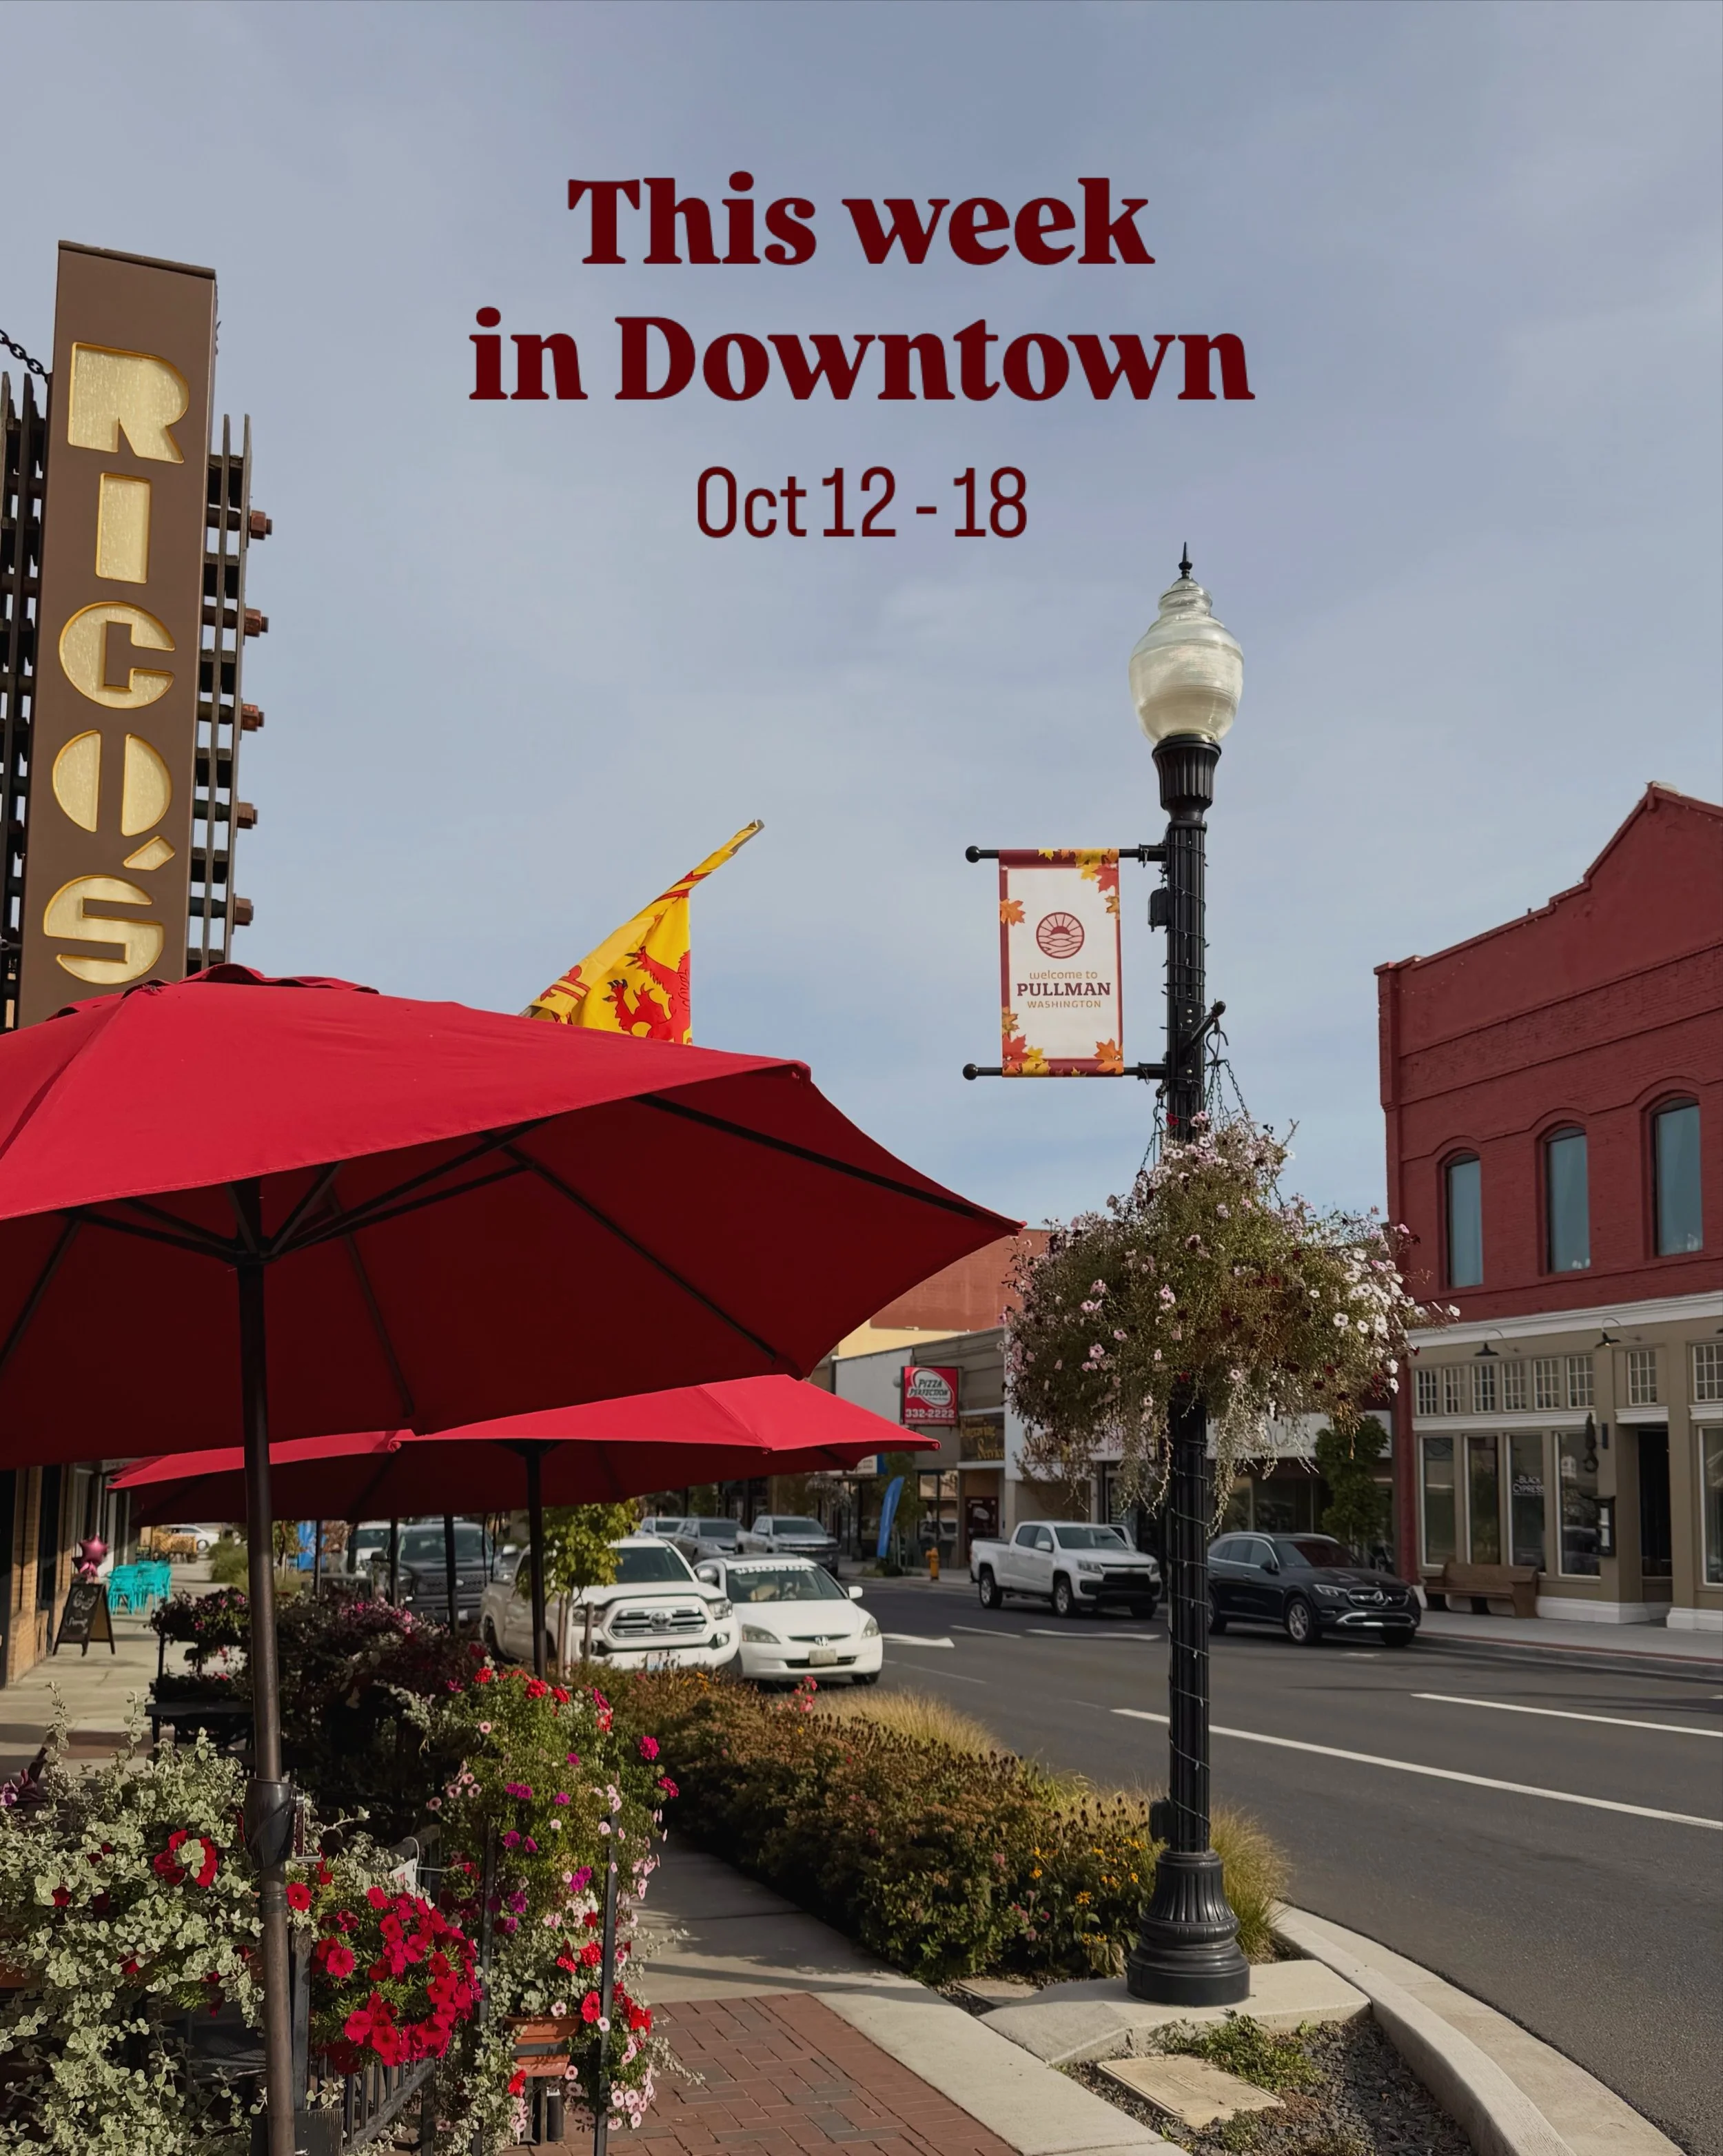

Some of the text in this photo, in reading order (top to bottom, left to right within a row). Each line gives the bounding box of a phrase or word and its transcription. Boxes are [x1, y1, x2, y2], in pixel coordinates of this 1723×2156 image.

[1029, 970, 1098, 979] welcome to
[1017, 982, 1111, 997] PULLMAN
[1027, 1000, 1101, 1008] WASHINGTON
[918, 1379, 943, 1388] PIZZA
[905, 1407, 955, 1418] 332-2222
